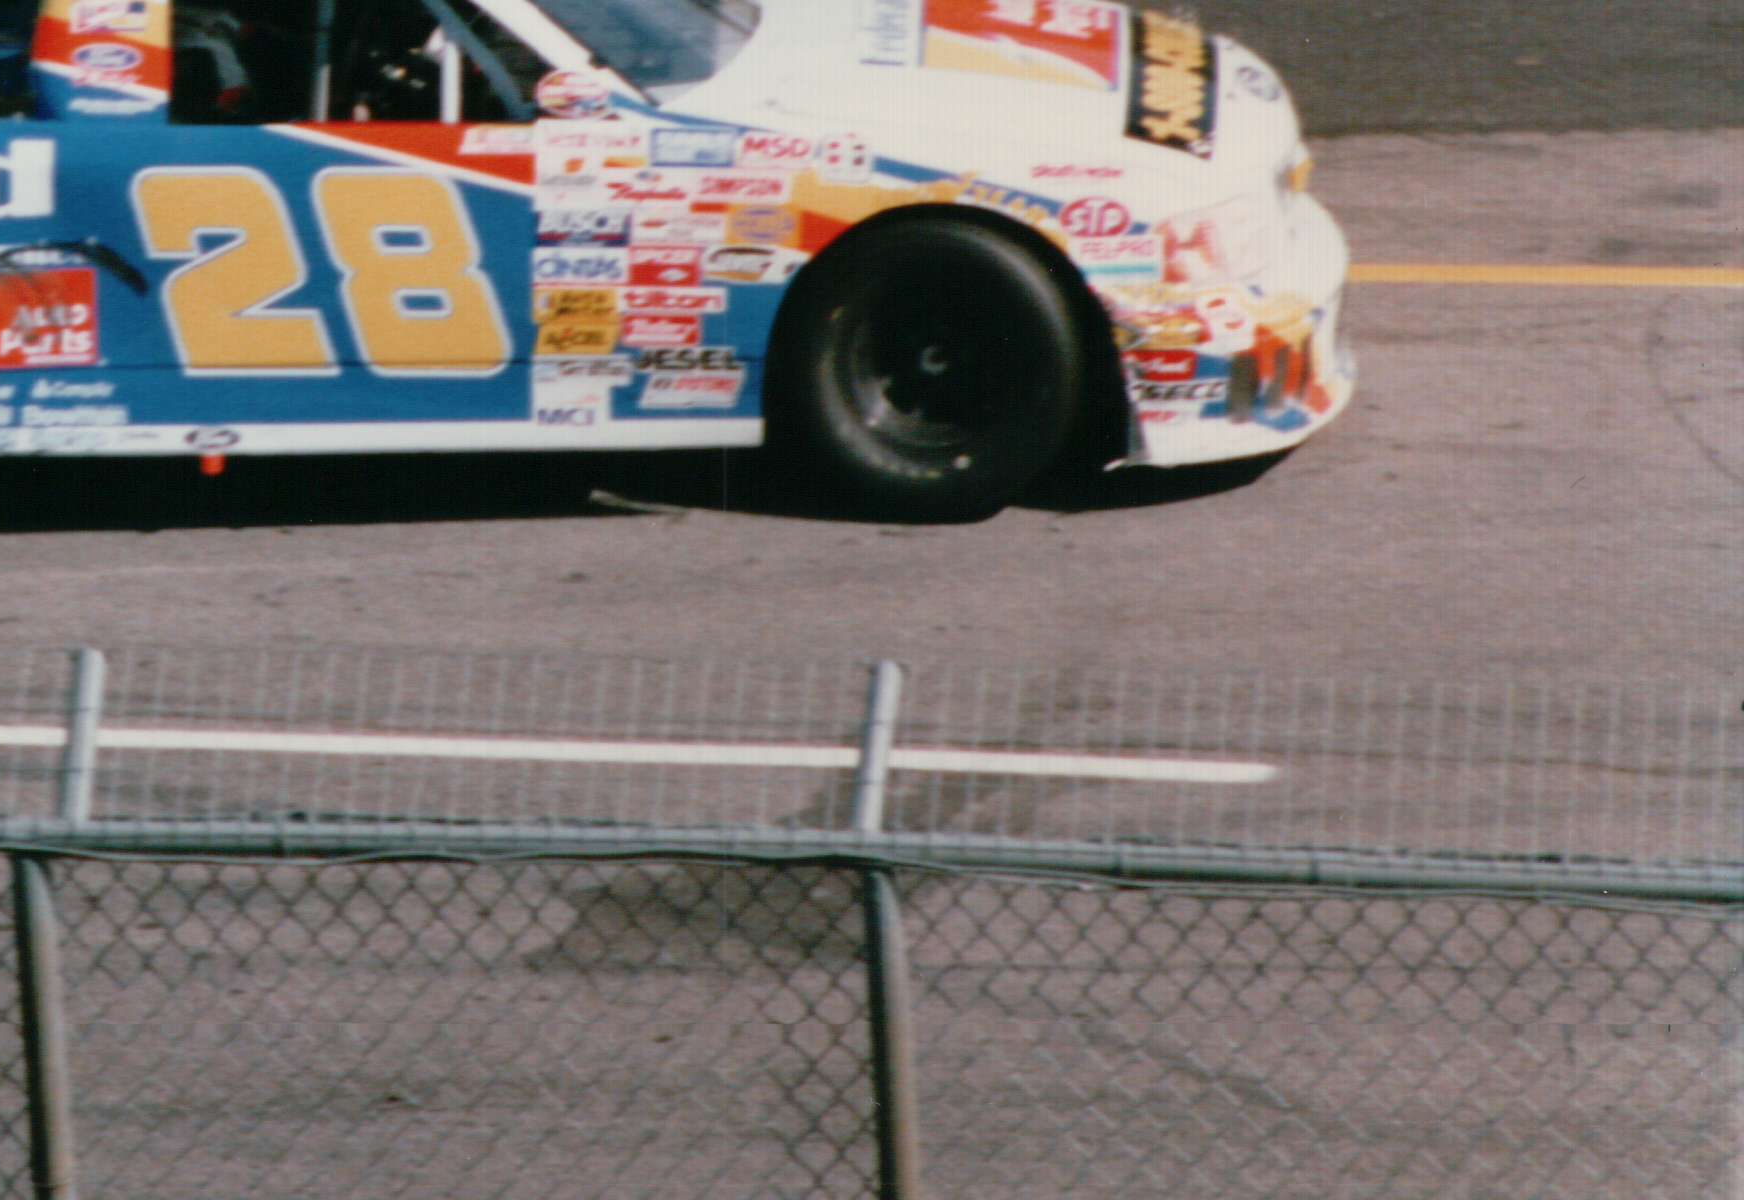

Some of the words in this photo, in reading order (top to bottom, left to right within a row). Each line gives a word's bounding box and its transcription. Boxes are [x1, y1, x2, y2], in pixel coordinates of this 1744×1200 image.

[742, 136, 810, 159] MSD
[1067, 199, 1125, 237] STP
[129, 164, 514, 378] 28
[636, 348, 740, 371] JESEL
